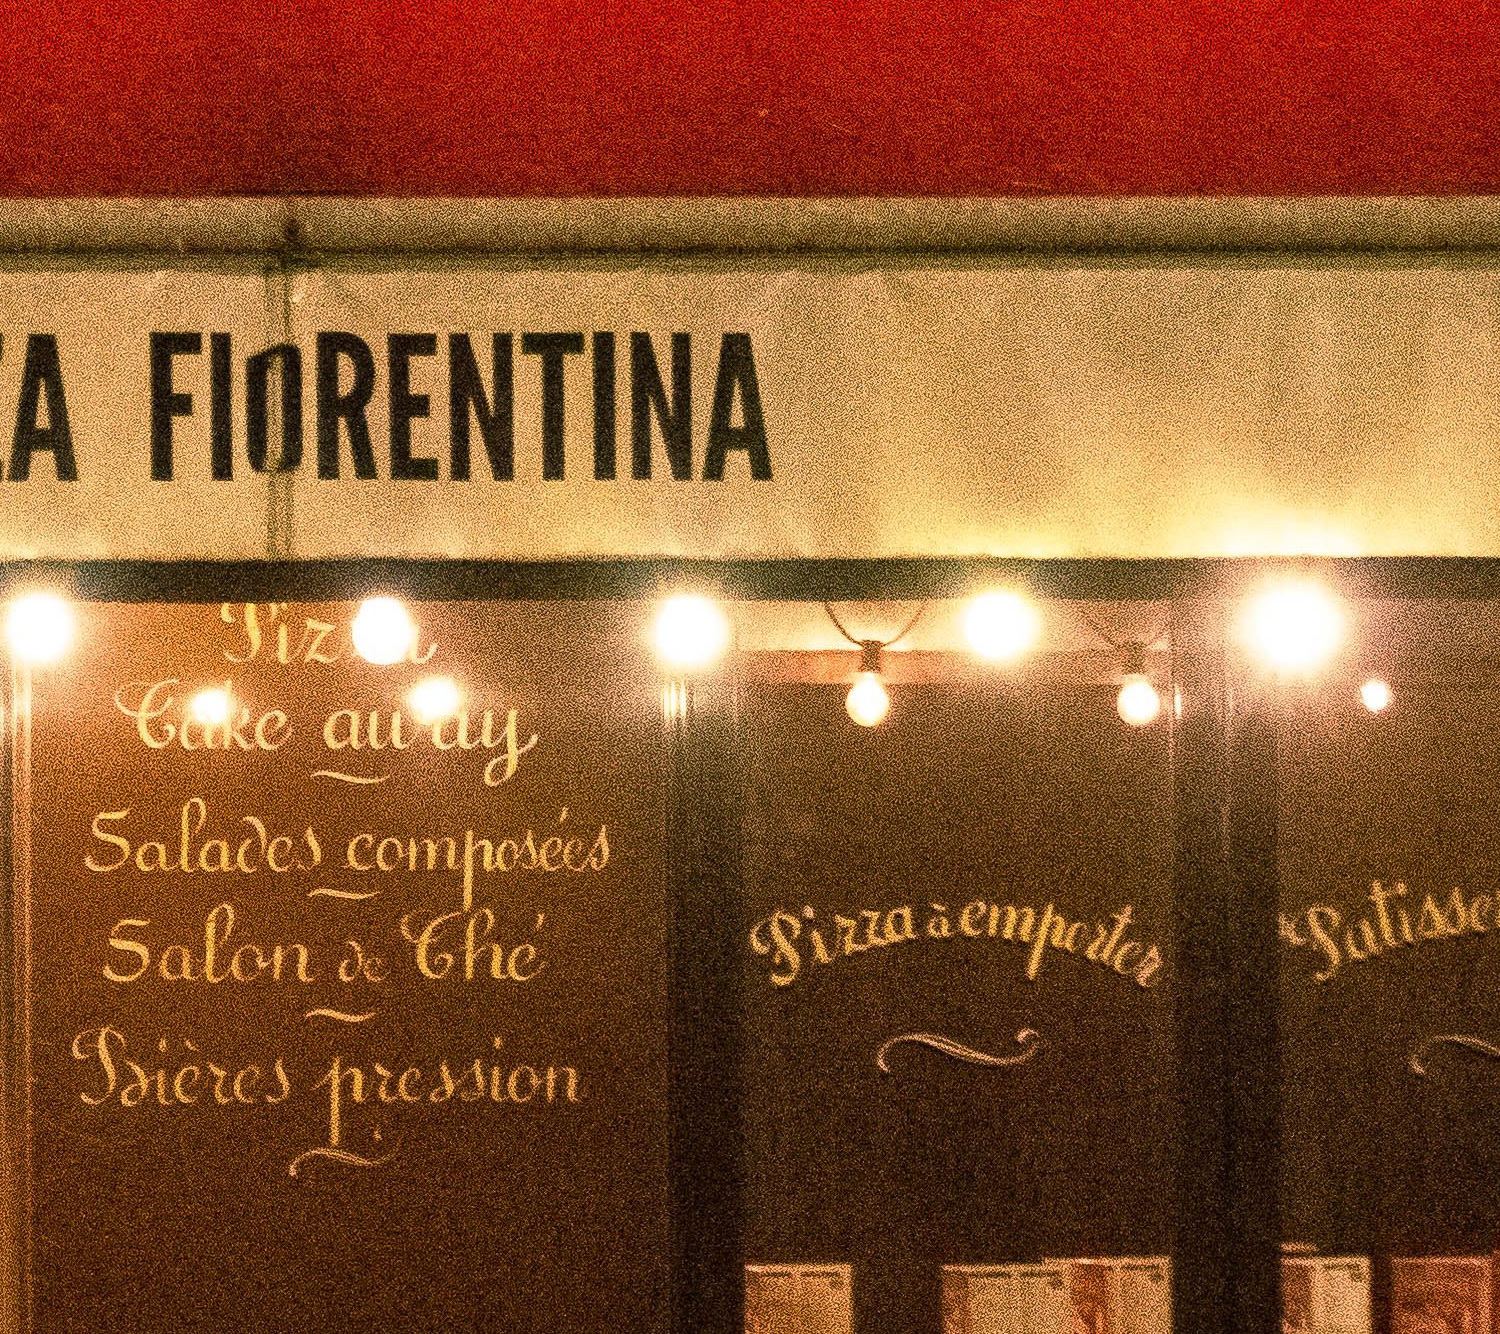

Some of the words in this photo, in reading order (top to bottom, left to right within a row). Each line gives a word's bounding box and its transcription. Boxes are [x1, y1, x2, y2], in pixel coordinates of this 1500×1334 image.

[149, 331, 773, 483] FIORENTINA
[85, 797, 322, 873] Salades
[347, 806, 611, 909] composées
[101, 903, 315, 984] Salon
[338, 940, 383, 983] de
[749, 904, 916, 987] Pizza
[927, 902, 951, 938] à
[960, 899, 1163, 987] emporter
[316, 1036, 589, 1145] pression
